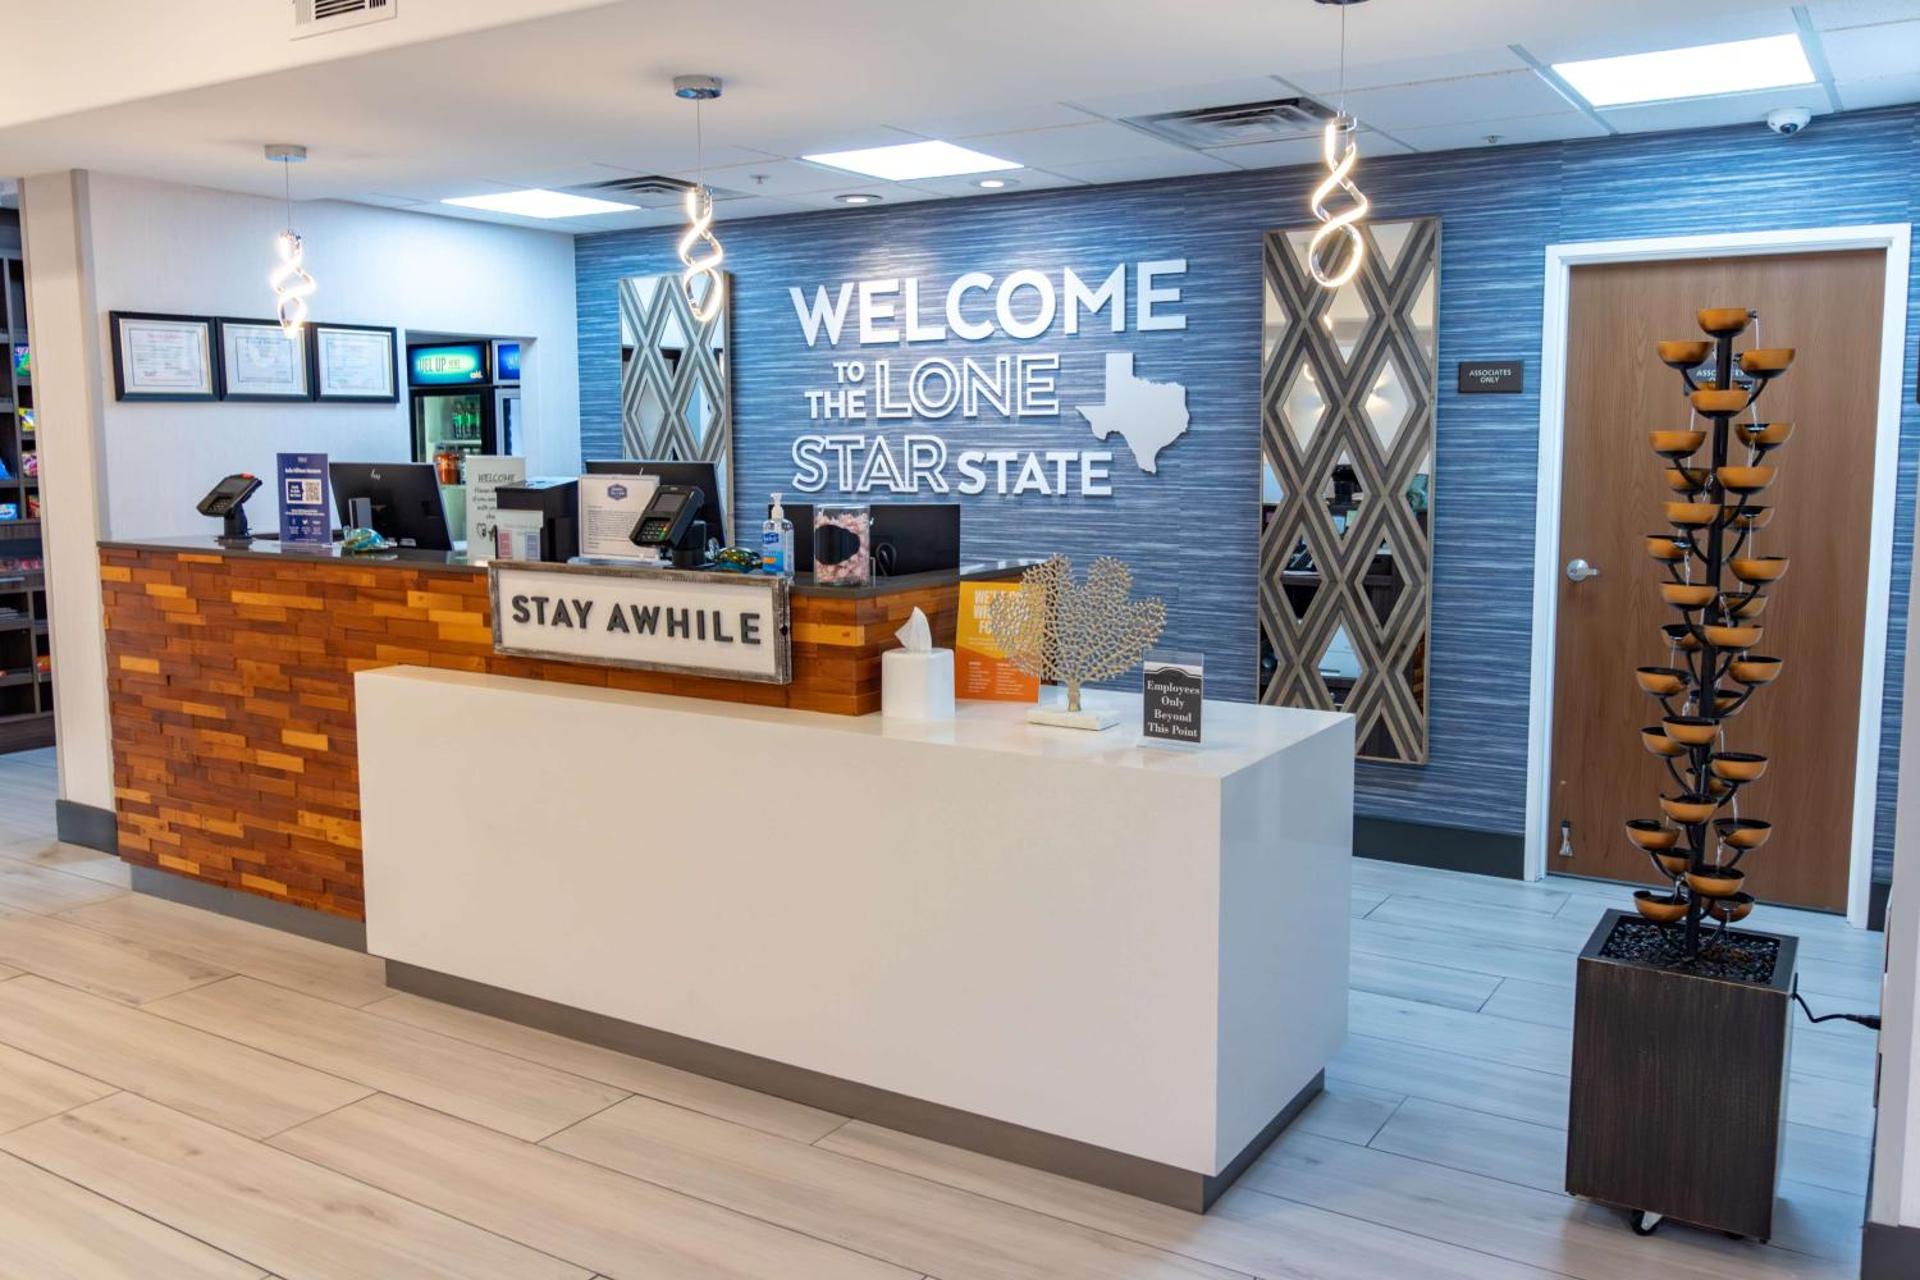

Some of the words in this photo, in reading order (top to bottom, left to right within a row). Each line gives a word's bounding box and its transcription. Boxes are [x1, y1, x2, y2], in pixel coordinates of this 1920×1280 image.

[788, 259, 1188, 347] WELCOME
[833, 361, 865, 383] TO
[1469, 368, 1512, 376] ASSOCIATES
[804, 390, 867, 419] THE
[875, 352, 1060, 419] LONE
[791, 434, 949, 495] STAR
[957, 451, 1113, 496] STATE
[478, 472, 515, 483] WELCOME
[511, 595, 594, 629] STAY
[606, 603, 762, 645] AWHILE
[1146, 679, 1200, 696] Employees
[1161, 695, 1184, 710] Only
[1153, 708, 1192, 722] Beyond
[1147, 721, 1169, 734] This
[1171, 724, 1198, 737] Point
